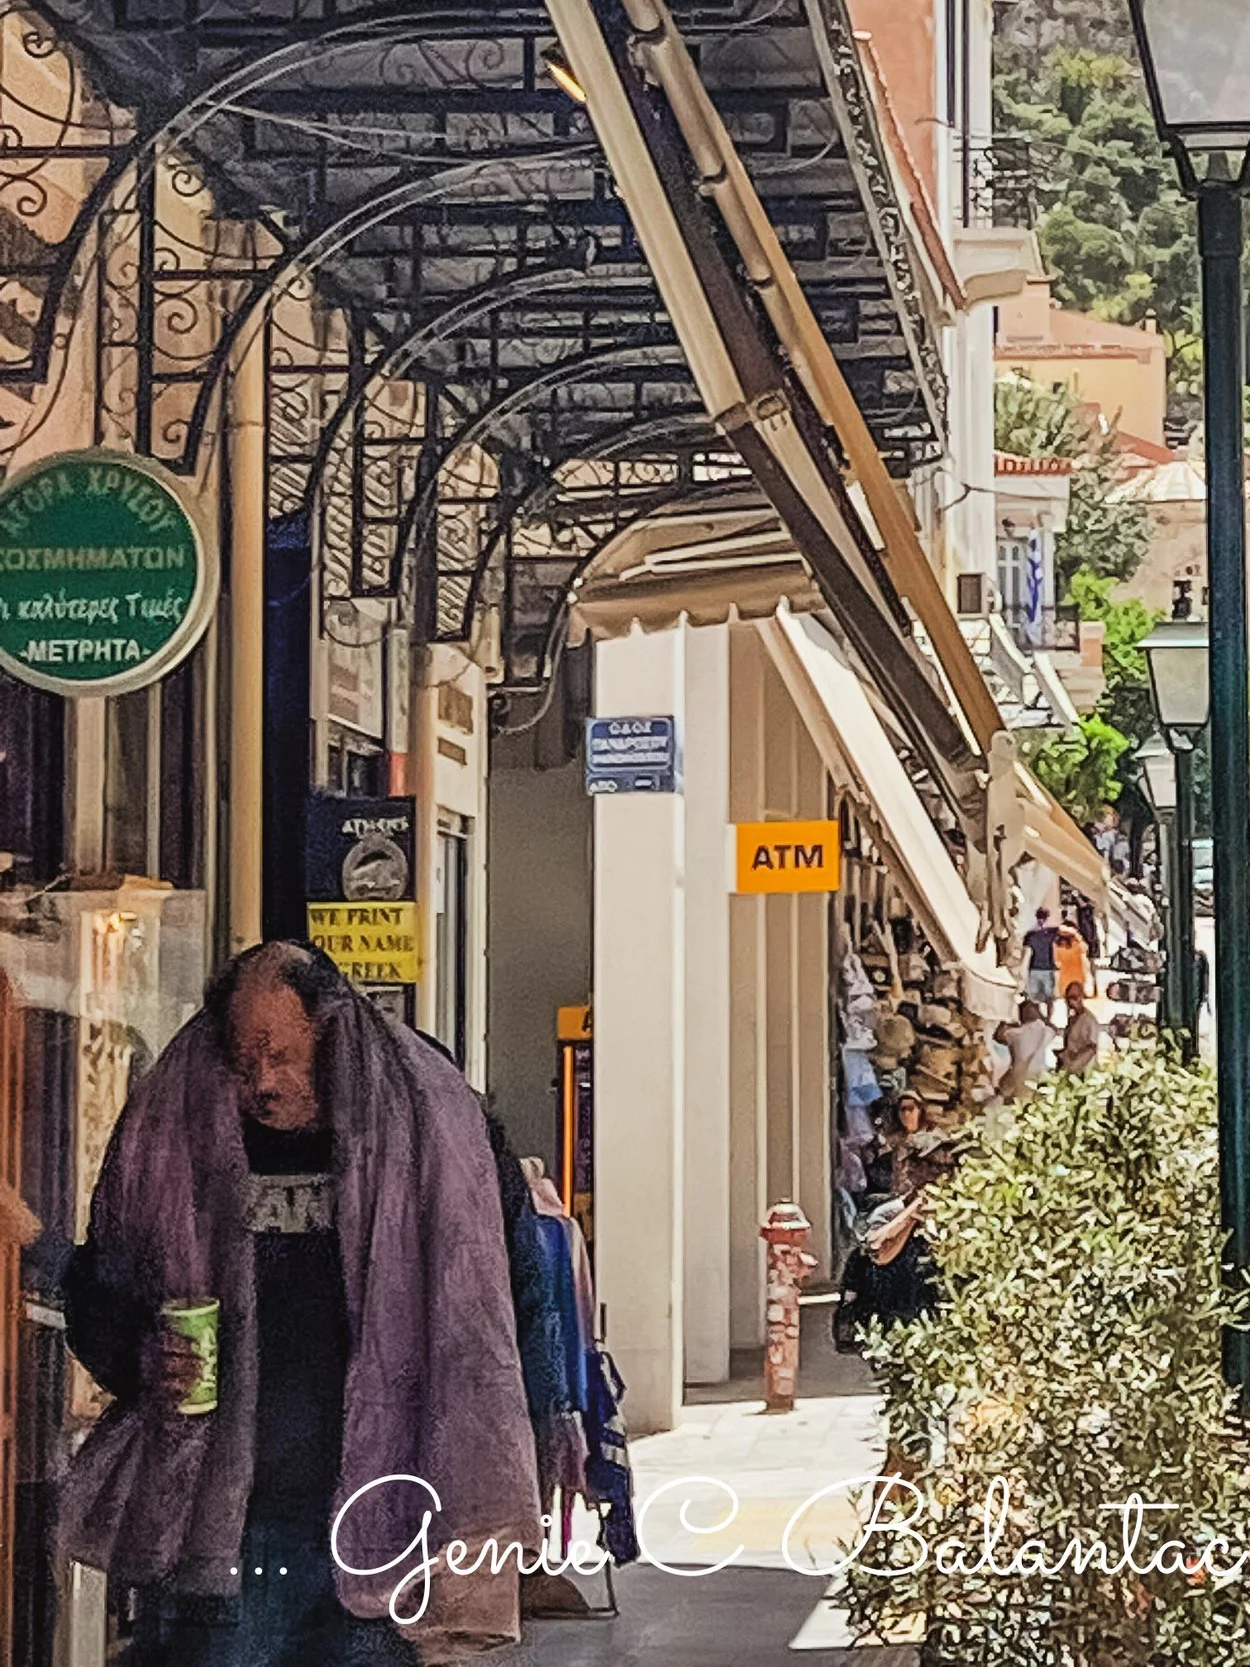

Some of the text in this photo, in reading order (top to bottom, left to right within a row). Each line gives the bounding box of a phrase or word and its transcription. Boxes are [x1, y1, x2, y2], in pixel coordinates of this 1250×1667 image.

[0, 545, 185, 571] ΟΣΜΗΜΑΤΩΝ
[751, 844, 824, 870] ATM
[310, 908, 404, 927] WE PRINT
[361, 934, 415, 953] NAME
